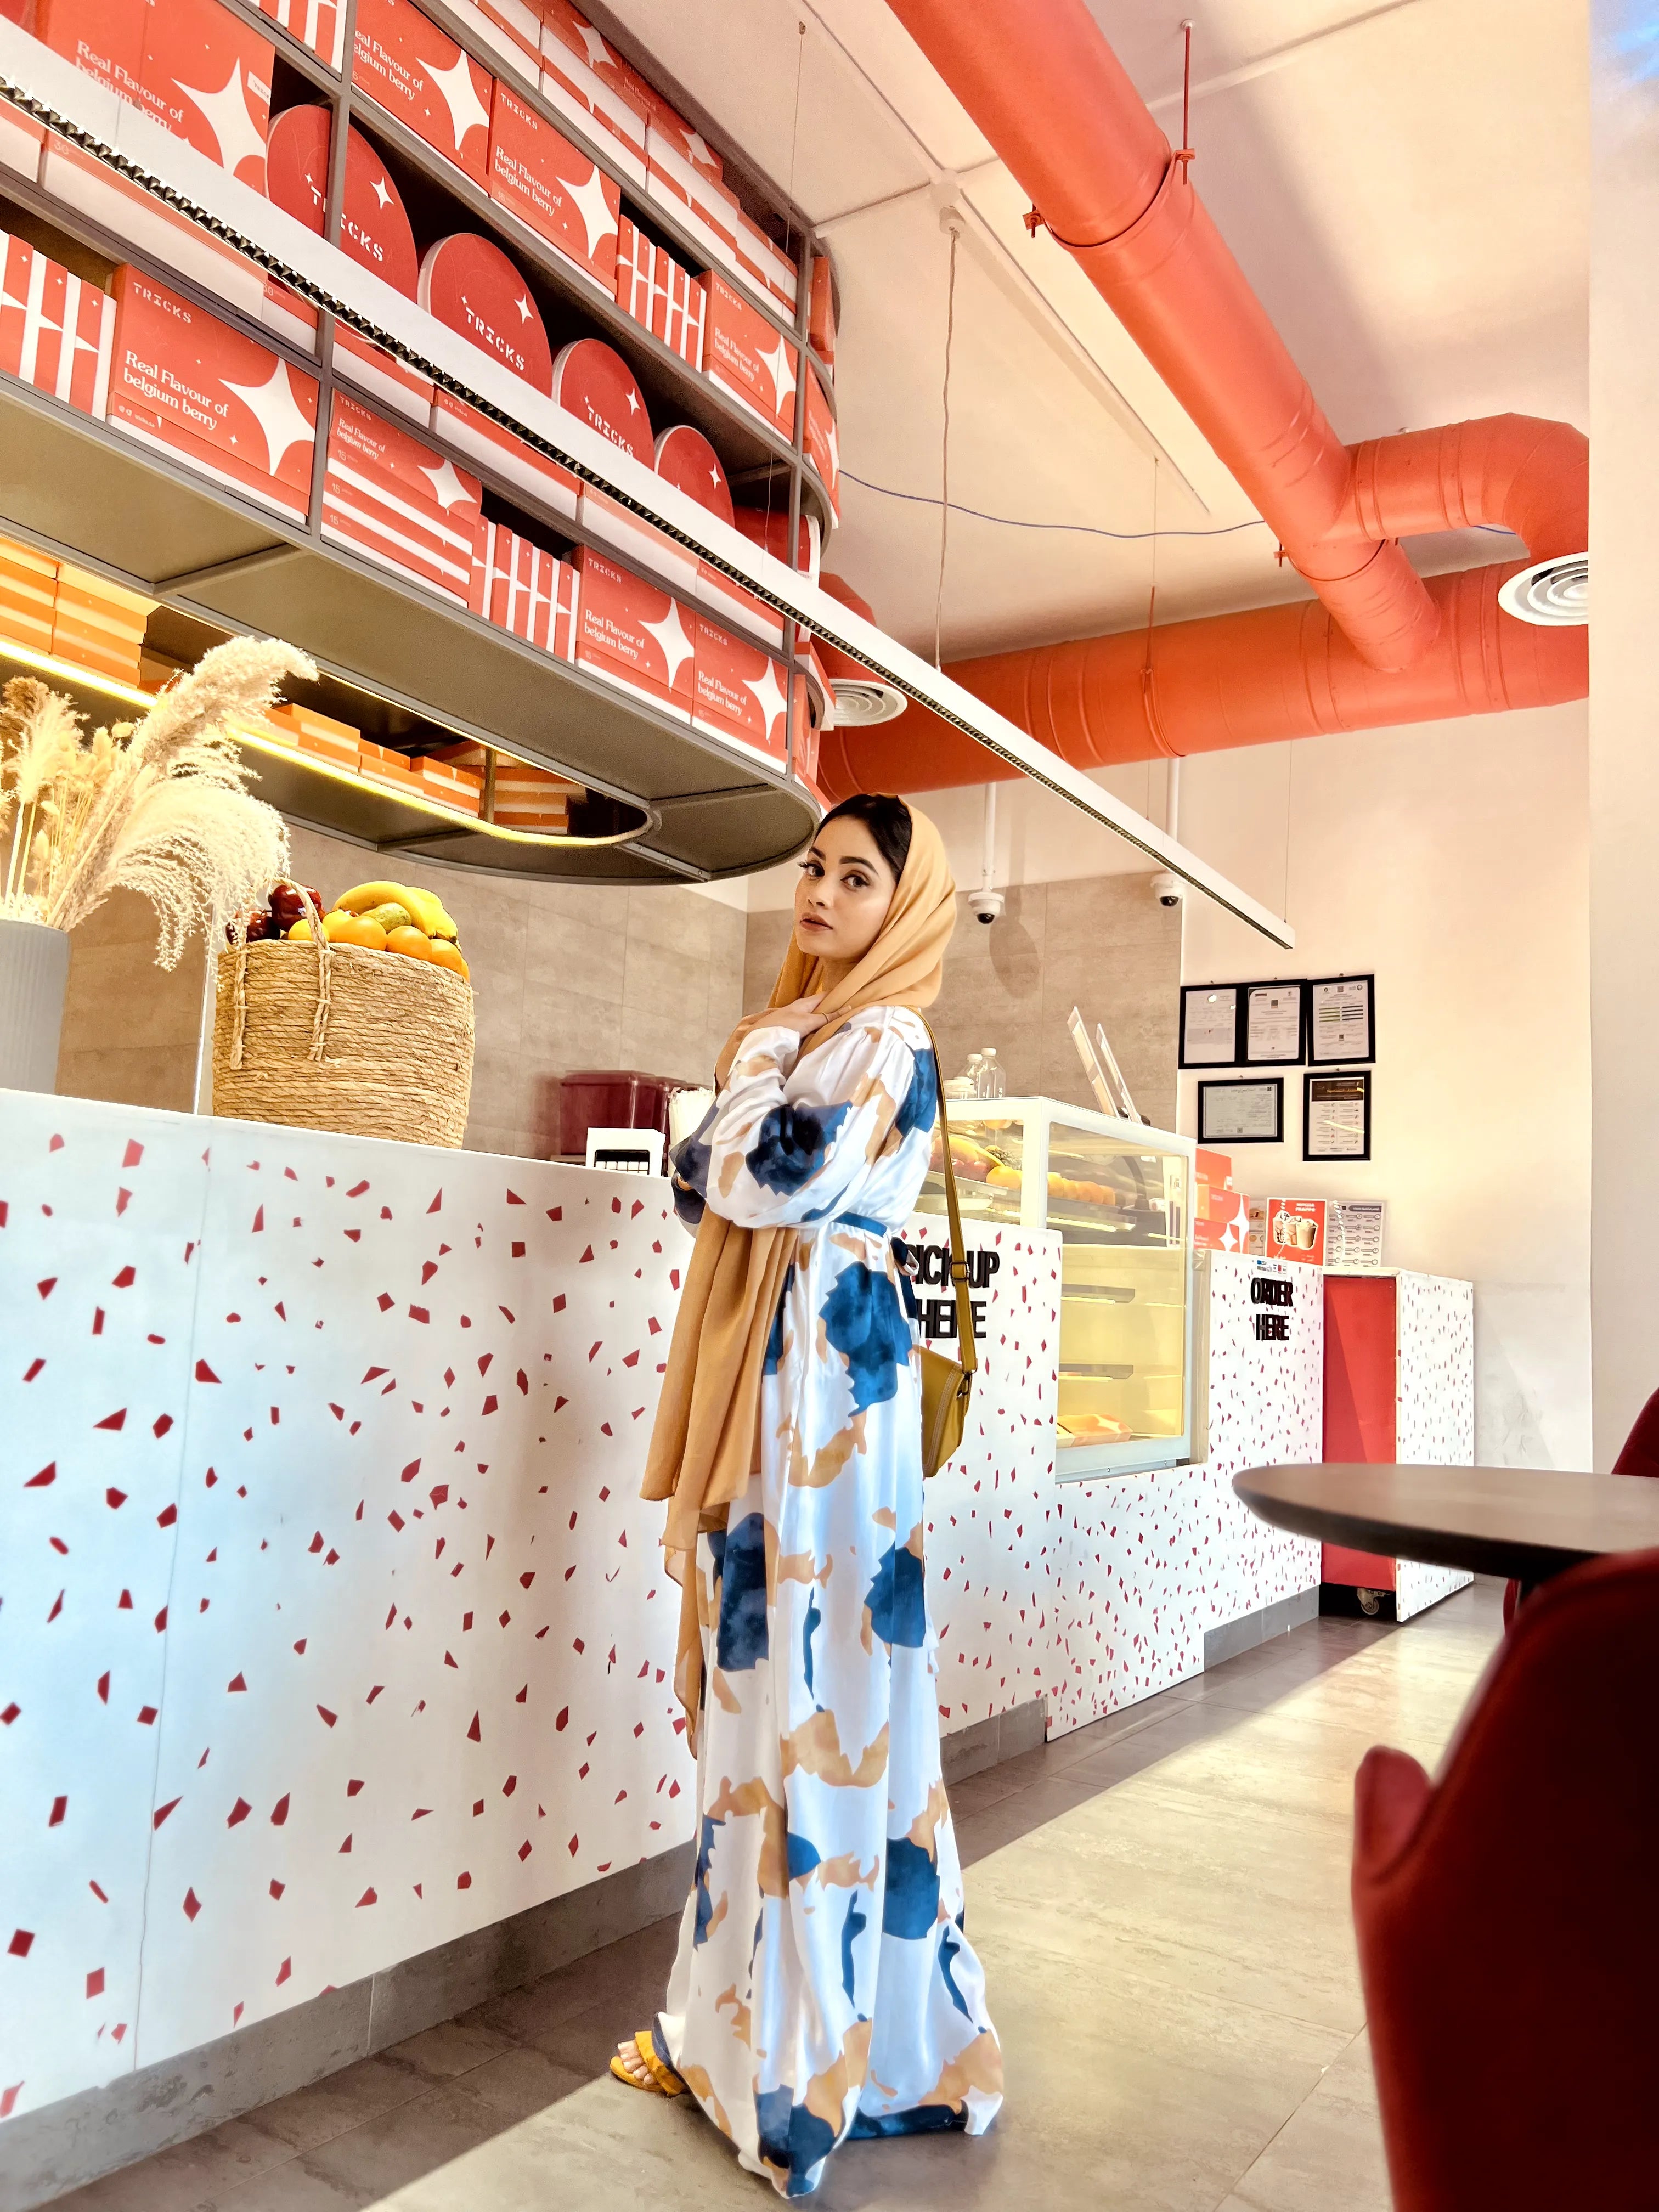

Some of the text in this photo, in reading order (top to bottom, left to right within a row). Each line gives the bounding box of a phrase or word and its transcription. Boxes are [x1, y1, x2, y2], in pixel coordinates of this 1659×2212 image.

[353, 43, 415, 100] elgium berry
[354, 30, 370, 48] eal
[373, 40, 411, 81] Flavour
[413, 80, 424, 92] of
[77, 40, 184, 123] Real Flavour of
[500, 92, 538, 131] TRICKS
[494, 162, 555, 217] belgium berry
[496, 145, 562, 207] Real Flavour of
[311, 185, 384, 262] TICKS
[133, 281, 193, 324] TRICKS
[715, 282, 743, 311] TRICKS
[465, 306, 526, 372] TRICKS
[714, 327, 760, 374] Real Flavour of
[714, 337, 755, 382] belgium berry
[123, 367, 217, 431] belgium berry
[125, 349, 229, 418] Real Flavour of
[340, 396, 371, 421] TRICKS
[336, 428, 362, 449] belgium
[362, 443, 380, 461] berry
[337, 449, 346, 461] 15
[338, 418, 386, 453] Real Flavour of
[331, 482, 341, 494] 15
[329, 514, 338, 526] 15
[588, 558, 623, 584] TRICKS
[584, 622, 639, 660] belgium berry
[585, 609, 645, 648] Real Flavour of
[699, 623, 728, 646] TRICKS
[697, 685, 742, 716] belgium berry
[698, 671, 747, 705] Real Flavour of
[967, 1250, 1000, 1289] UP
[1250, 1277, 1294, 1307] ORDER
[1255, 1314, 1289, 1342] HERE
